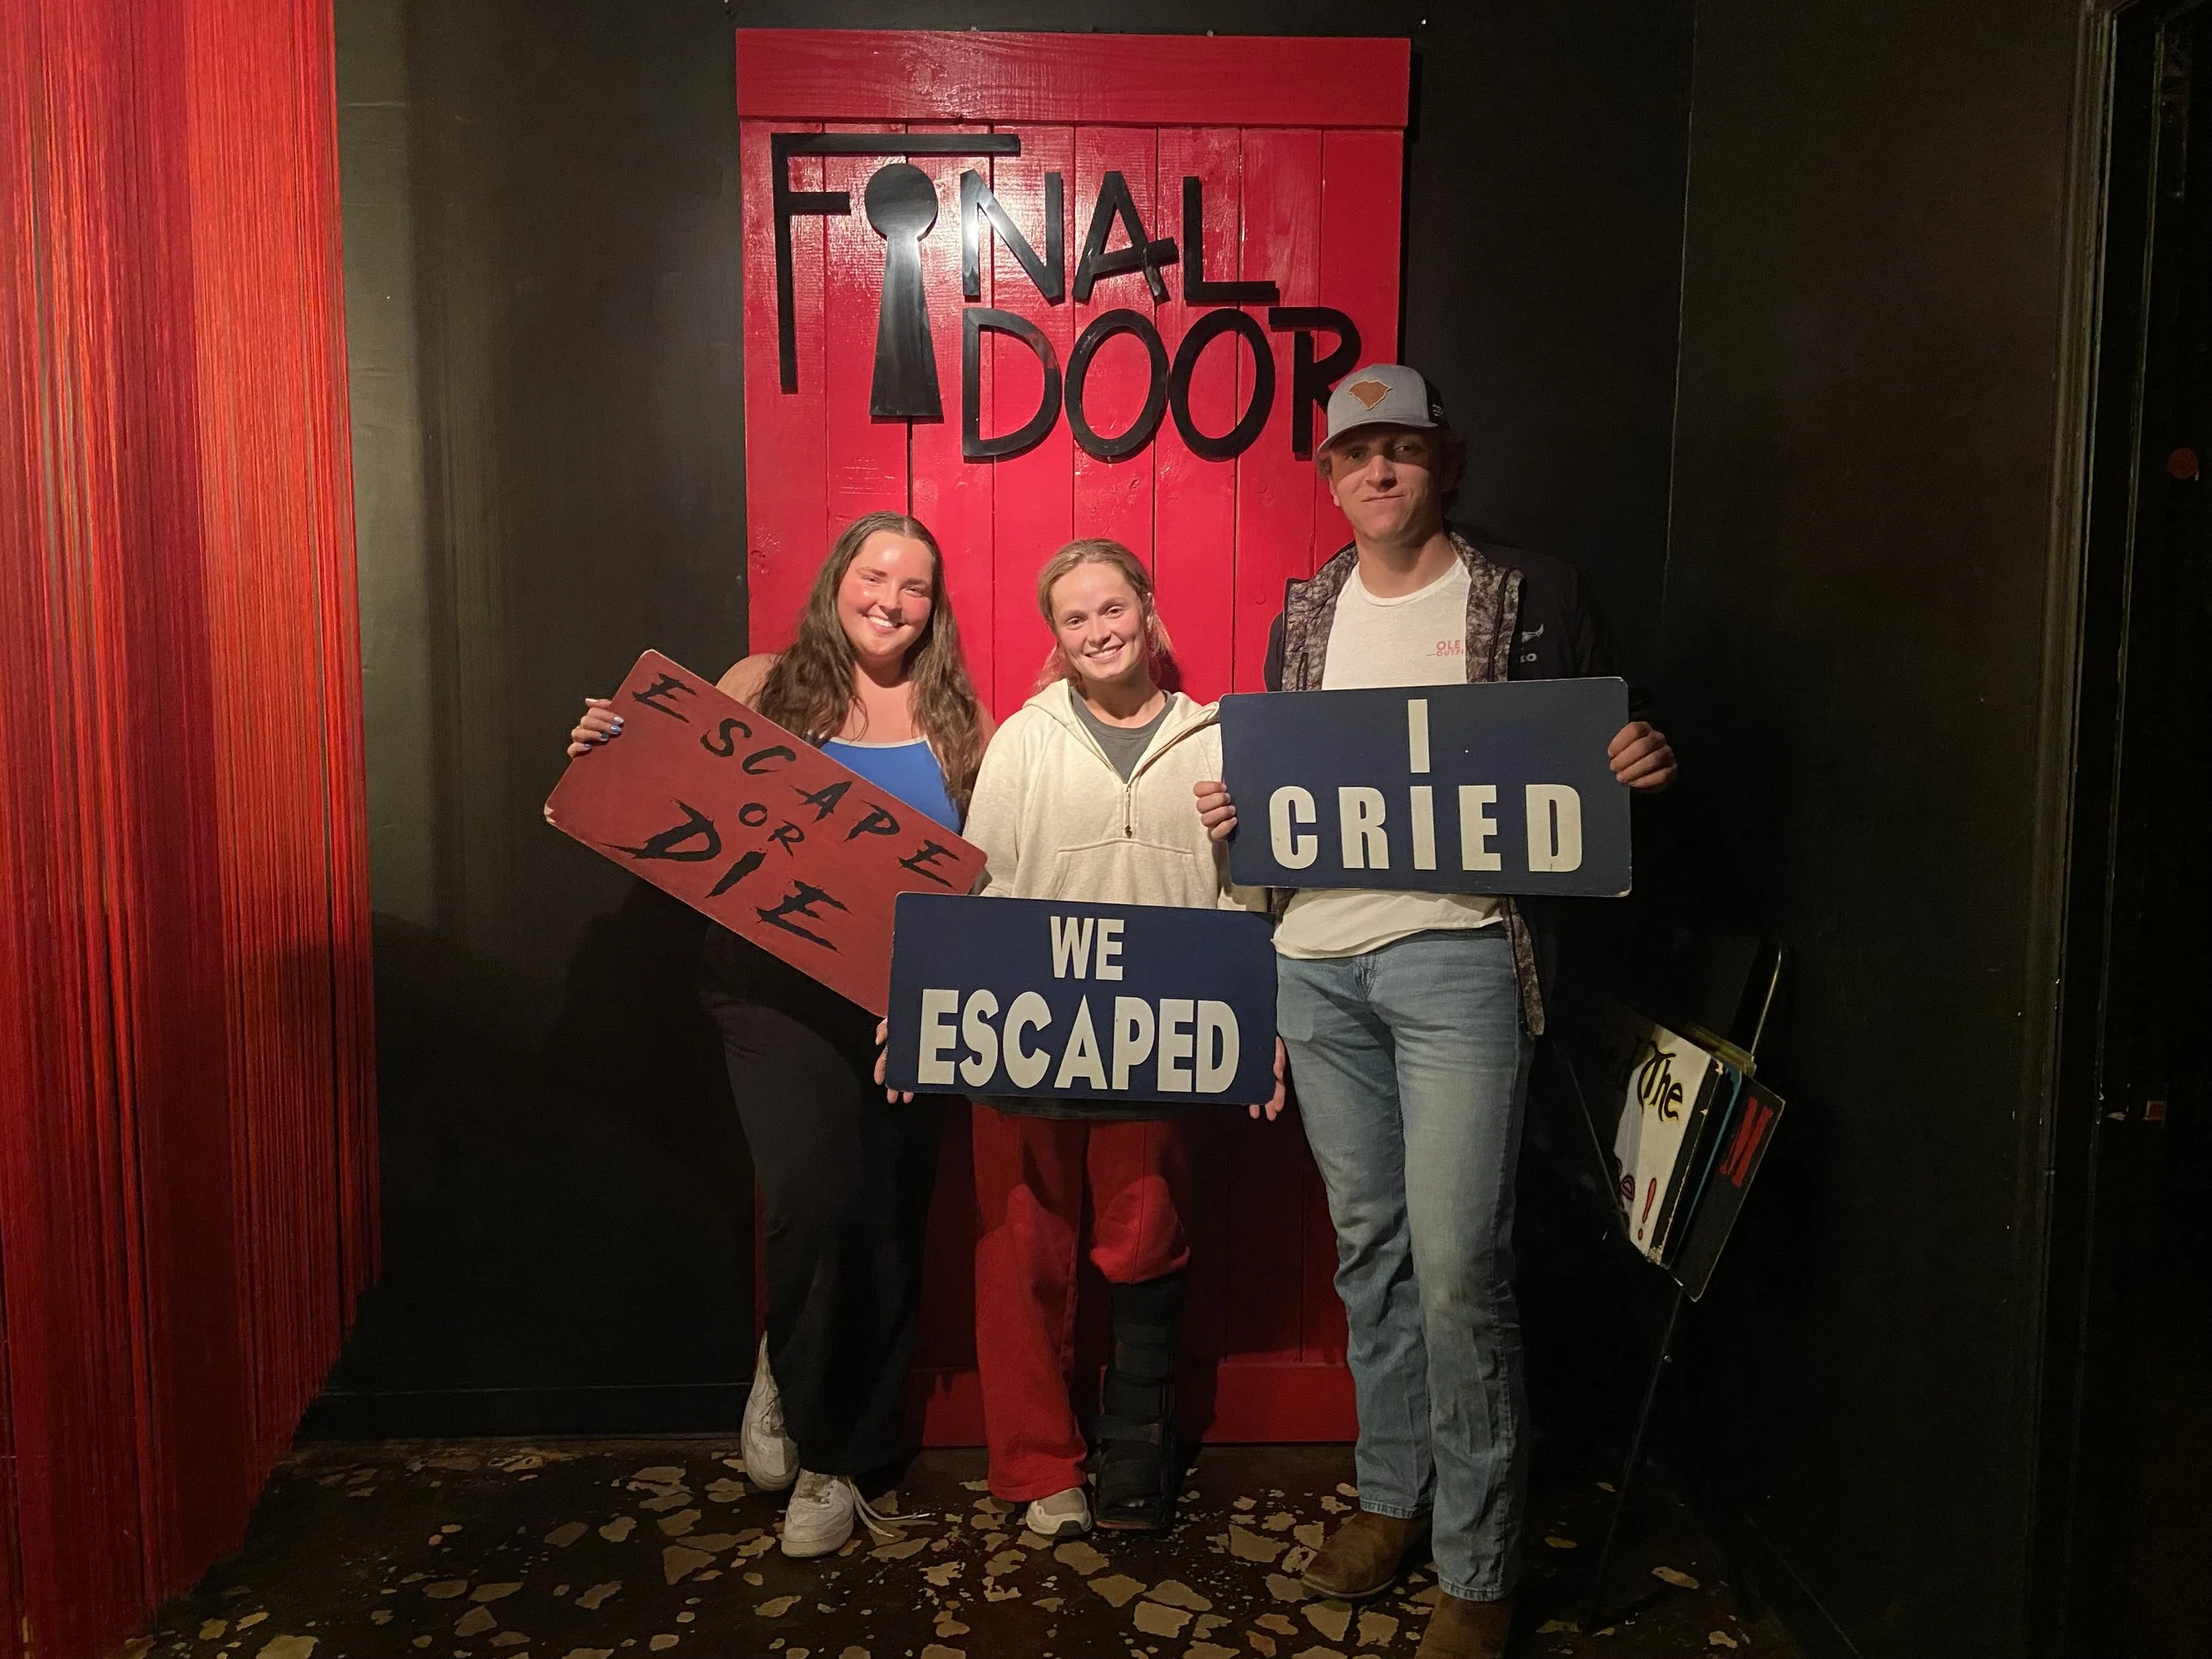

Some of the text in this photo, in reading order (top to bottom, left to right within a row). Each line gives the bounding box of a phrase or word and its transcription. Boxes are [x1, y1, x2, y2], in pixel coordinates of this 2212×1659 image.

[771, 133, 1279, 424] FINAL
[963, 306, 1363, 463] DOOR
[632, 672, 960, 890] ESCAPE
[1408, 698, 1431, 773] I
[738, 802, 805, 856] OR
[1269, 784, 1583, 872] CRIED
[597, 798, 854, 956] DIE
[1050, 916, 1125, 980] WE
[918, 988, 1240, 1094] ESCAPED
[1638, 1041, 1683, 1122] The
